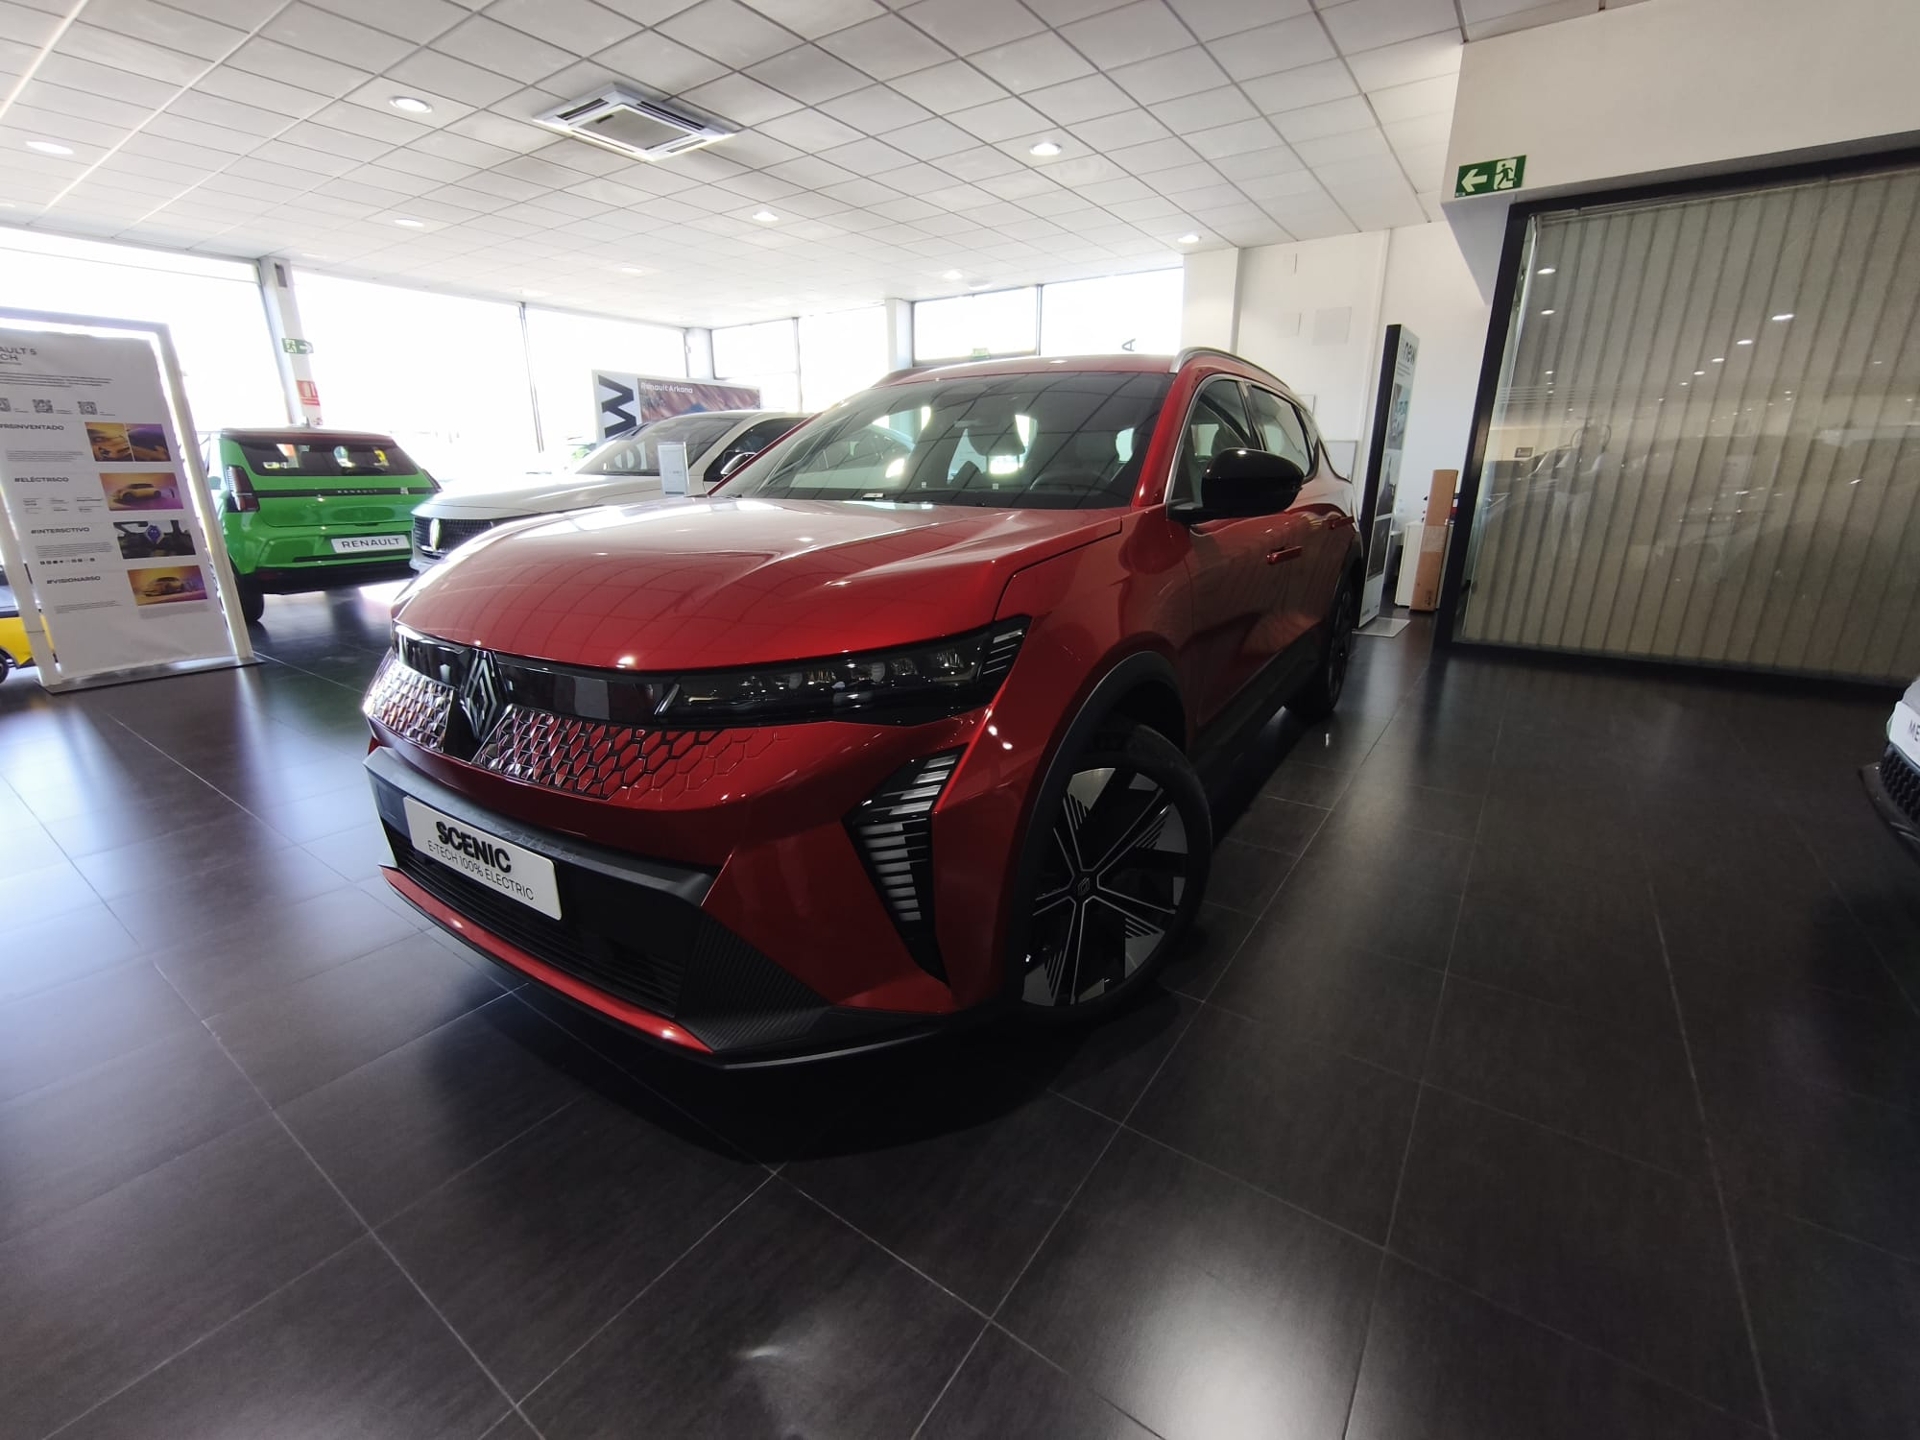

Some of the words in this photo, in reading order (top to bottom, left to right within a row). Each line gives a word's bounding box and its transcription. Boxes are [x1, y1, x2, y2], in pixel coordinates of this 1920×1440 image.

[668, 385, 693, 394] Arkana
[341, 537, 400, 549] RENAULT
[436, 820, 512, 874] SCENIC
[428, 839, 459, 864] E-TECH
[459, 855, 484, 877] 100%
[485, 868, 534, 901] ELECTRIC
